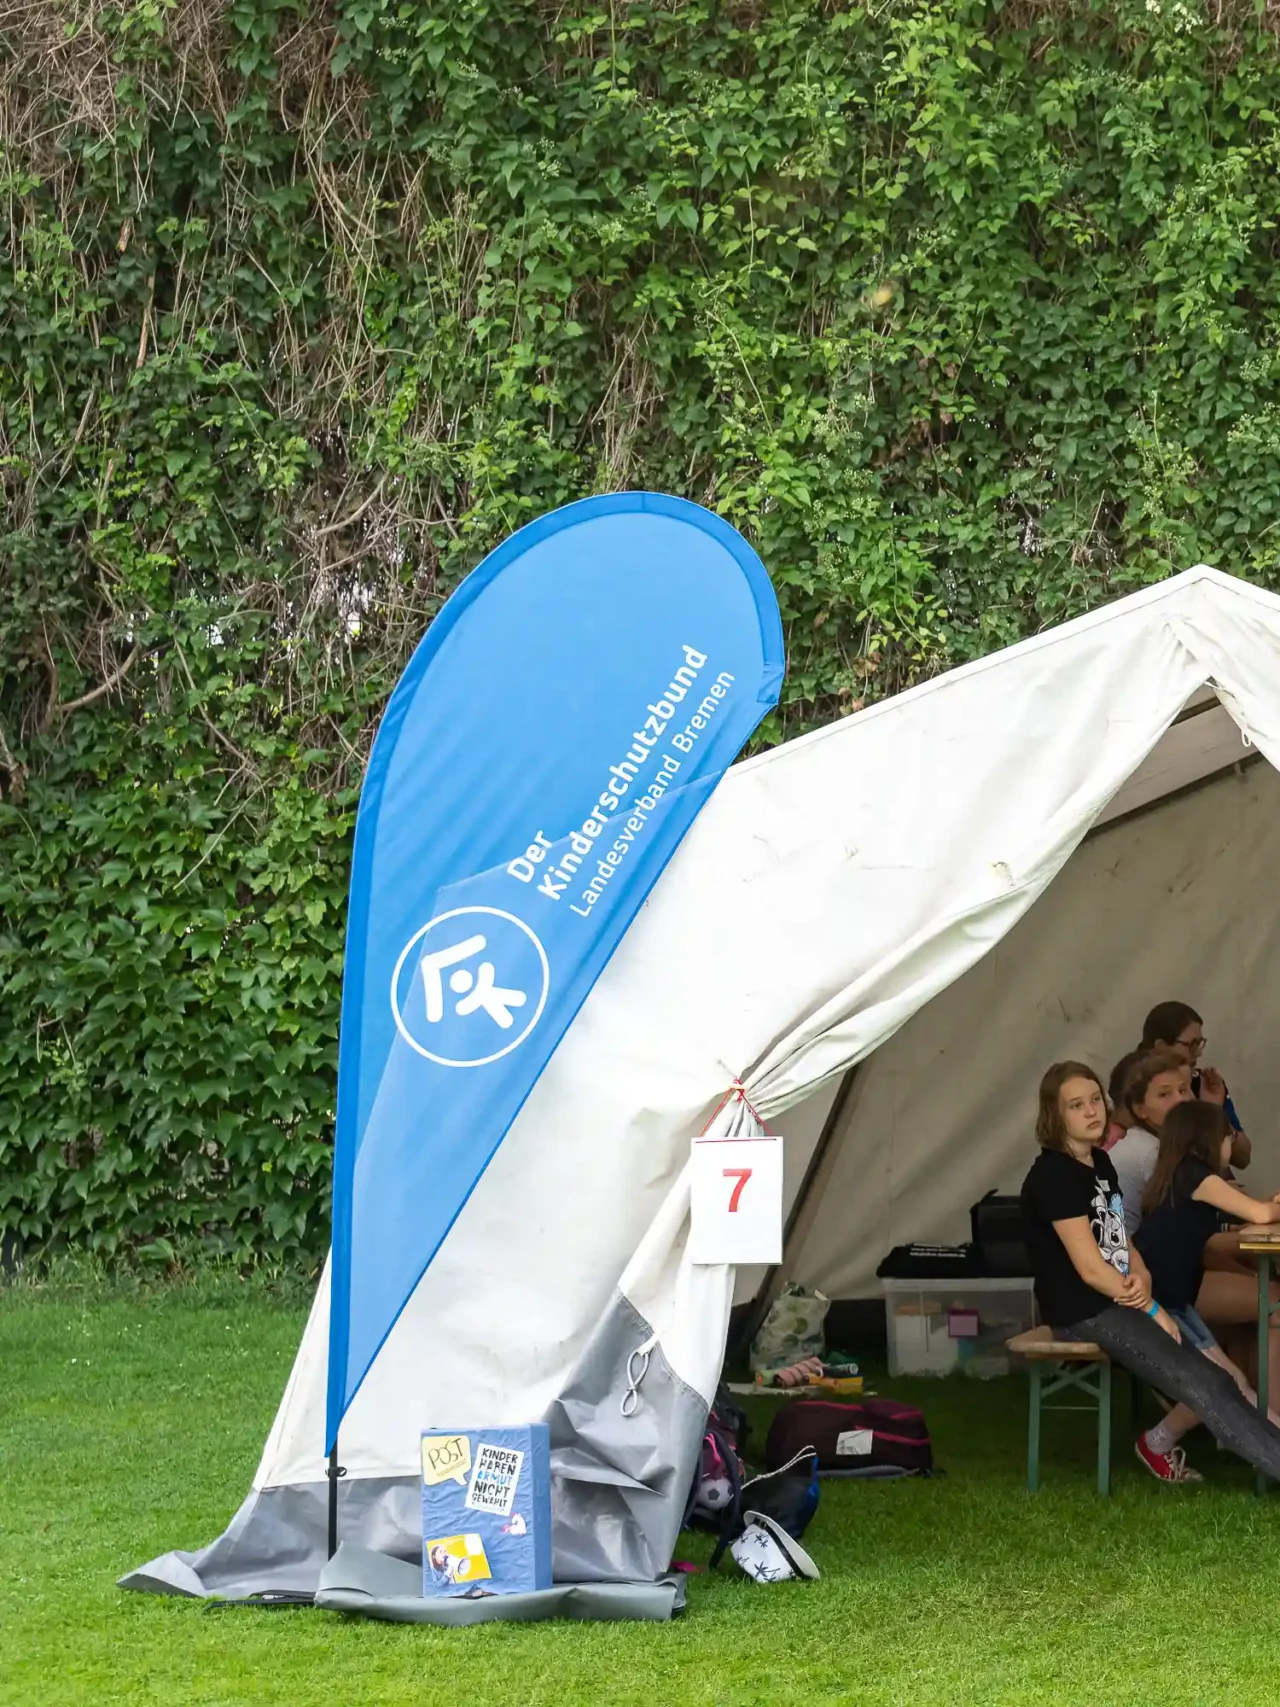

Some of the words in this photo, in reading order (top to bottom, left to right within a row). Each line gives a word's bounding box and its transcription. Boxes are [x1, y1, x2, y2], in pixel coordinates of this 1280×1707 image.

[537, 645, 708, 900] Kinderschutzbund
[570, 754, 681, 917] Landesverband
[671, 671, 735, 753] Bremen
[507, 830, 552, 883] Der
[722, 1168, 753, 1213] 7
[428, 1437, 463, 1470] POST
[481, 1447, 518, 1464] KINDER
[473, 1480, 510, 1498] NICHT
